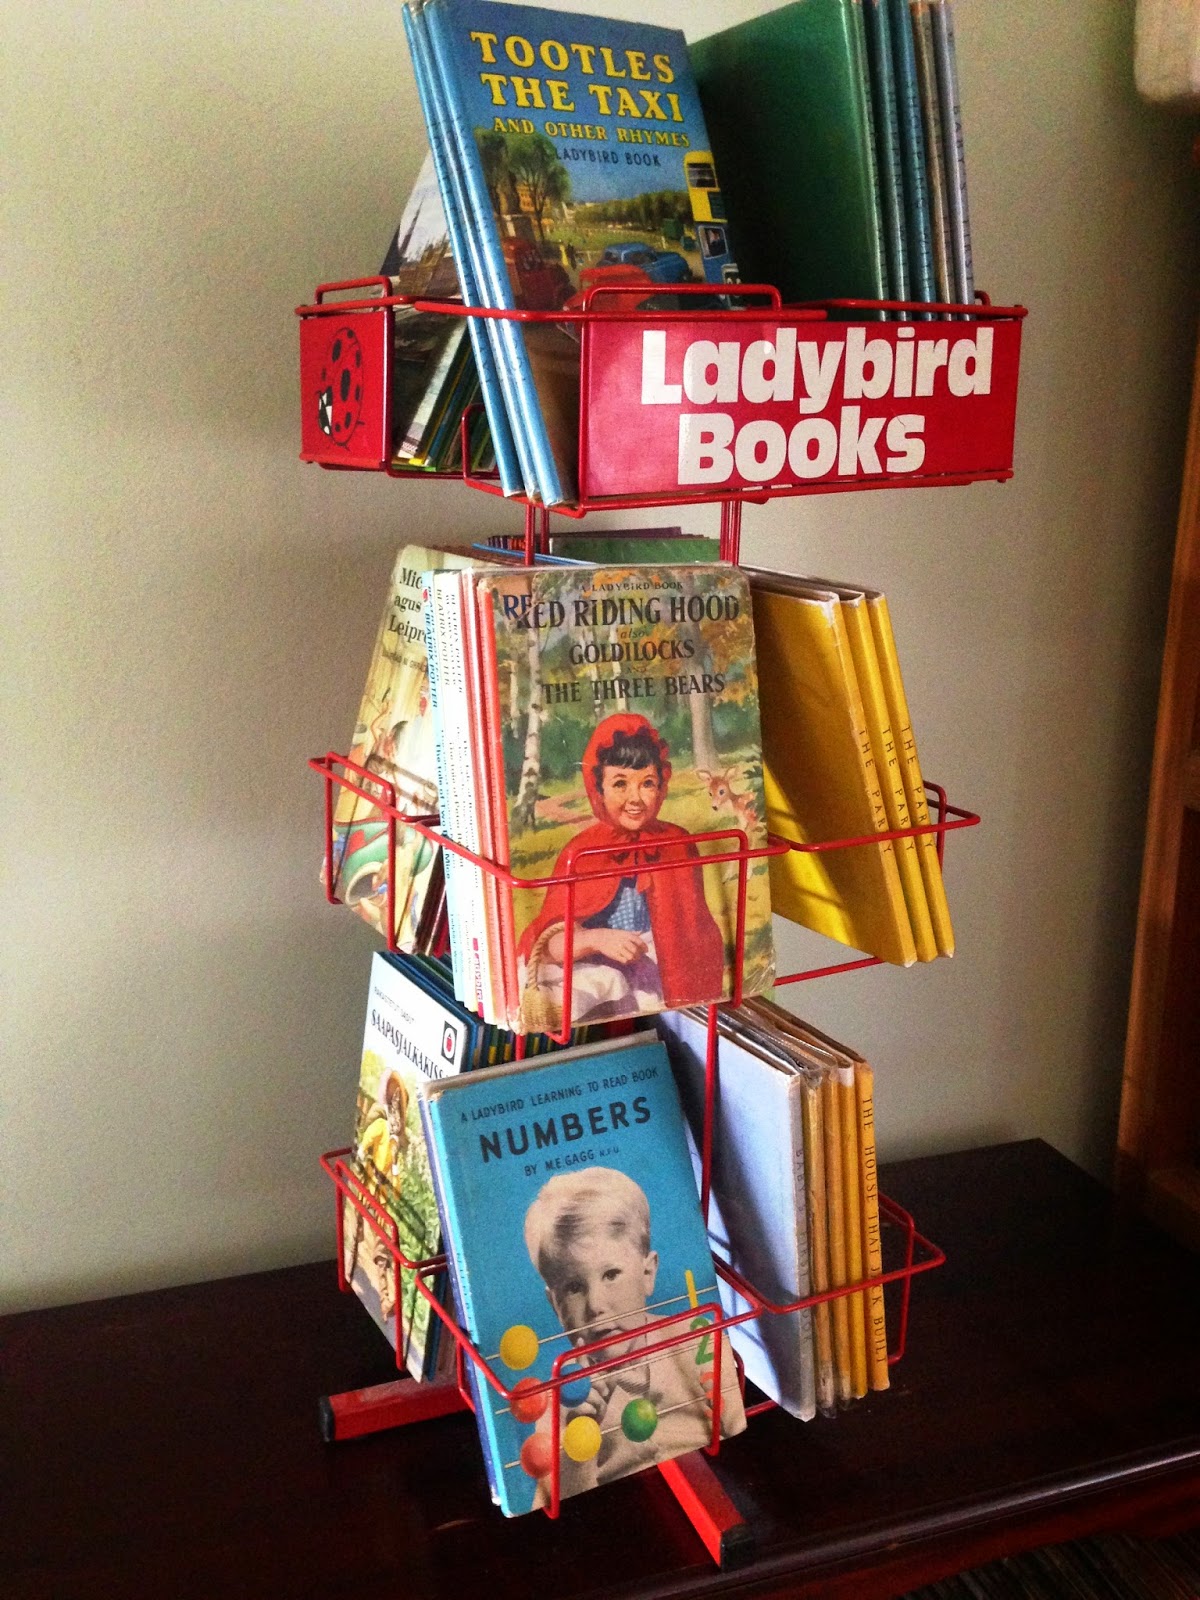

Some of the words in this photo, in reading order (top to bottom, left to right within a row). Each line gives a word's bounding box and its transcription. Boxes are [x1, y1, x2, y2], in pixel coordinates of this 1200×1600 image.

[469, 31, 675, 84] TOOTLES
[479, 72, 575, 112] THE
[587, 83, 684, 122] TAXI
[493, 117, 535, 135] AND
[544, 121, 608, 141] OTHER
[616, 127, 690, 148] RHYMES
[625, 152, 661, 167] BOOK
[641, 327, 994, 414] Ladybird
[677, 405, 925, 485] Books
[394, 595, 422, 612] agus
[592, 582, 650, 592] LADYBIRD
[655, 582, 684, 590] BOOK
[574, 597, 660, 627] RIDING
[670, 595, 740, 623] HOOD
[620, 626, 645, 639] also
[424, 613, 435, 661] BEATRIX
[569, 639, 695, 665] GOLDILOCKS
[428, 664, 438, 708] POTTER
[541, 681, 582, 705] THE
[590, 677, 656, 700] THREE
[665, 673, 726, 696] BEARS
[859, 727, 874, 768] THE
[872, 790, 892, 852] PARY
[883, 725, 896, 767] THE
[895, 788, 914, 850] PARY
[902, 725, 916, 765] THE
[914, 786, 932, 847] PARY
[371, 1009, 448, 1079] SAAPASJALKAKISS
[461, 1112, 468, 1122] A
[471, 1099, 524, 1121] LADYBIRD
[531, 1085, 582, 1107] LEARNING
[587, 1082, 599, 1093] TO
[603, 1075, 628, 1090] READ
[633, 1067, 659, 1083] BOOK
[863, 1098, 873, 1131] THE
[479, 1096, 651, 1163] NUMBERS
[524, 1164, 537, 1177] BY
[864, 1145, 877, 1203] HOUSE
[868, 1215, 880, 1254] THAT
[871, 1266, 882, 1305] JCK
[801, 1308, 812, 1344] OOK
[873, 1317, 886, 1363] BUILT
